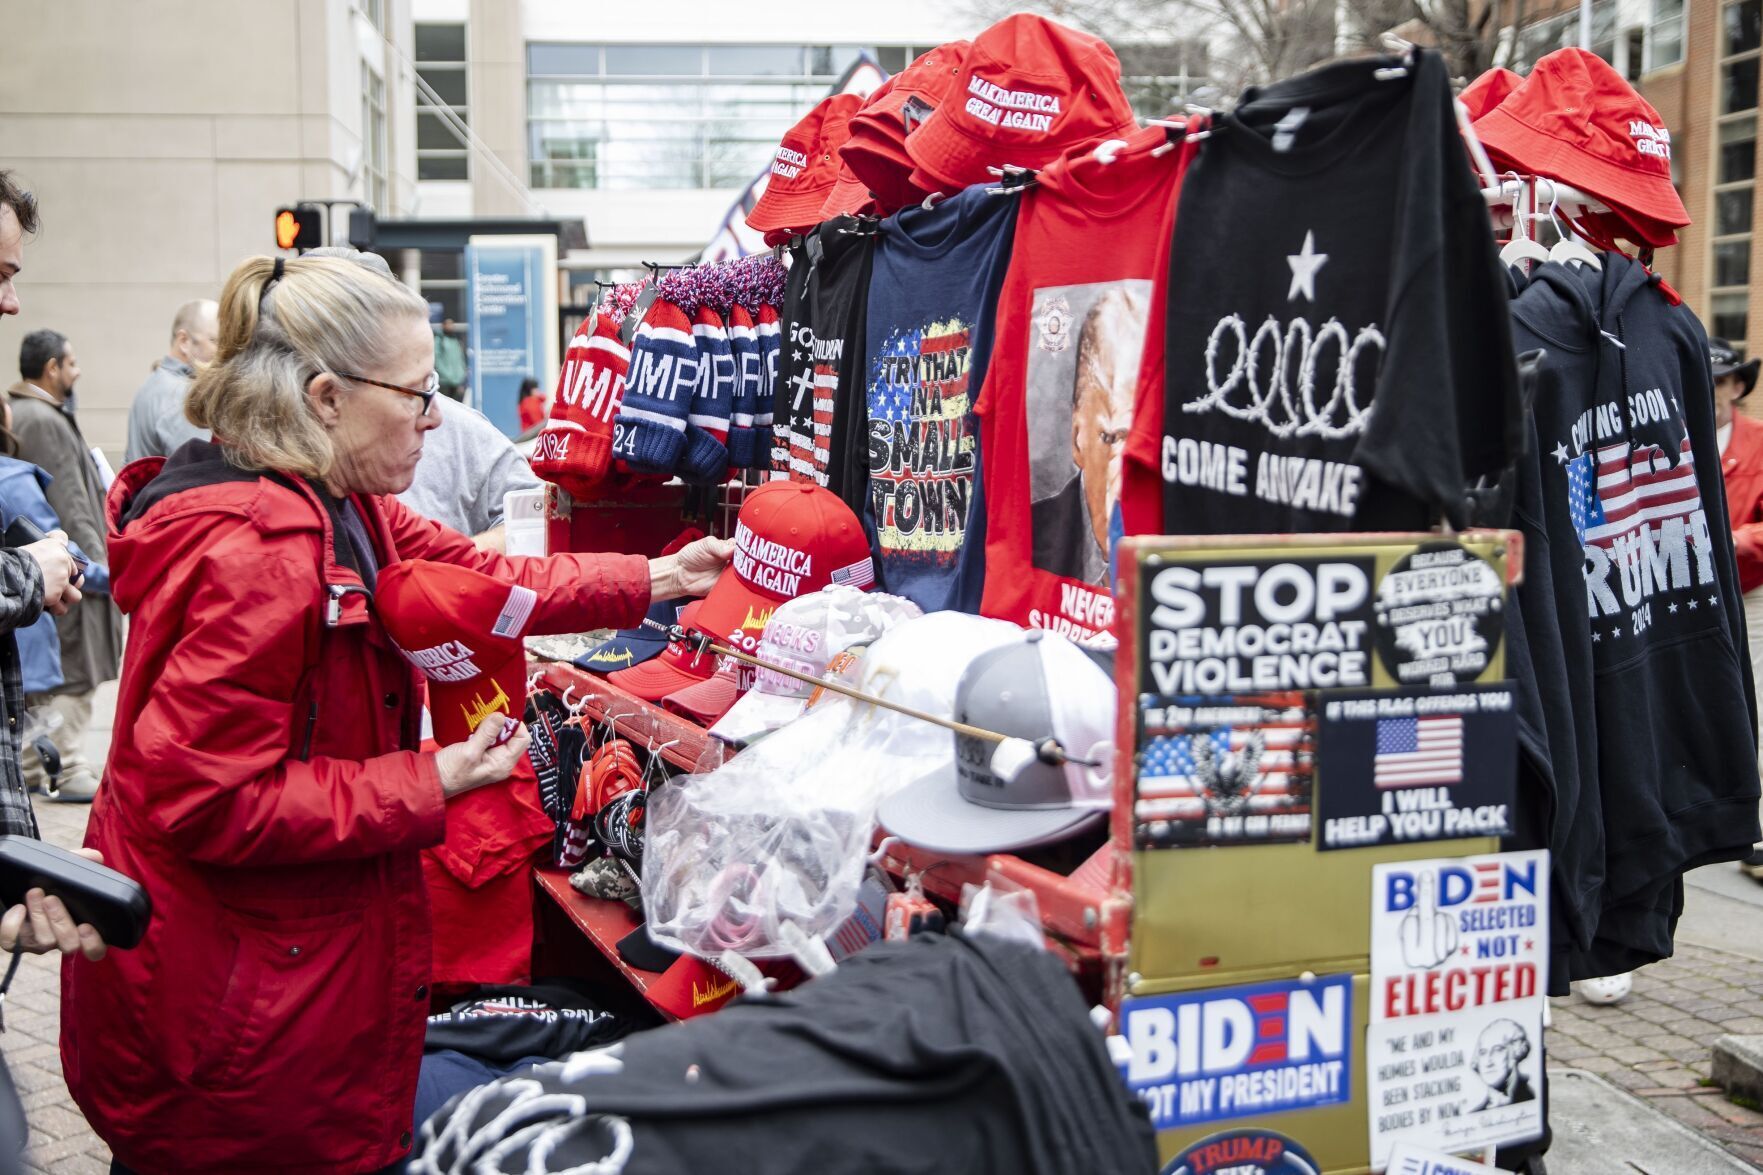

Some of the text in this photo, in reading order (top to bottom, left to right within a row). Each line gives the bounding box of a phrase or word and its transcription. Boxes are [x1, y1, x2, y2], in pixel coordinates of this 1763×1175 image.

[1000, 110, 1054, 132] AGAIN
[883, 346, 968, 387] TRY THAT
[909, 385, 943, 417] IN A
[1627, 387, 1670, 429] SOON
[868, 417, 975, 476] SMALL
[1161, 435, 1249, 496] COME
[871, 476, 969, 537] TOWN
[748, 535, 812, 577] AMERICA
[1582, 509, 1715, 618] RUMP
[753, 564, 801, 597] AGAIN
[1150, 563, 1369, 630] STOP
[1393, 566, 1482, 594] EVERYONE
[1060, 582, 1116, 628] NEVER
[1149, 620, 1367, 663] DEMOCRAT
[1418, 620, 1466, 650] YOU
[1150, 651, 1367, 697] VIOLENCE
[1343, 699, 1377, 719] THIS
[1377, 697, 1415, 716] FLAG
[1414, 694, 1478, 714] OFFENDS
[1478, 691, 1512, 712] YOU
[1381, 786, 1454, 815] I WILL
[1325, 804, 1508, 847] HELP YOU PACK
[1459, 904, 1536, 933] SELECTED
[1477, 935, 1520, 959] NOT
[1384, 962, 1538, 1018] ELECTED
[1127, 984, 1345, 1083] BIDEN
[1412, 1031, 1433, 1050] AND
[1438, 1026, 1455, 1044] MY
[1378, 1050, 1465, 1082] HOMIES WOULDA
[1137, 1061, 1342, 1120] OT MY PRESIDENT
[1383, 1076, 1462, 1107] BEEN STACKING
[1378, 1110, 1414, 1134] BODIES
[1419, 1105, 1432, 1125] BY
[1187, 1136, 1284, 1174] TRUMP
